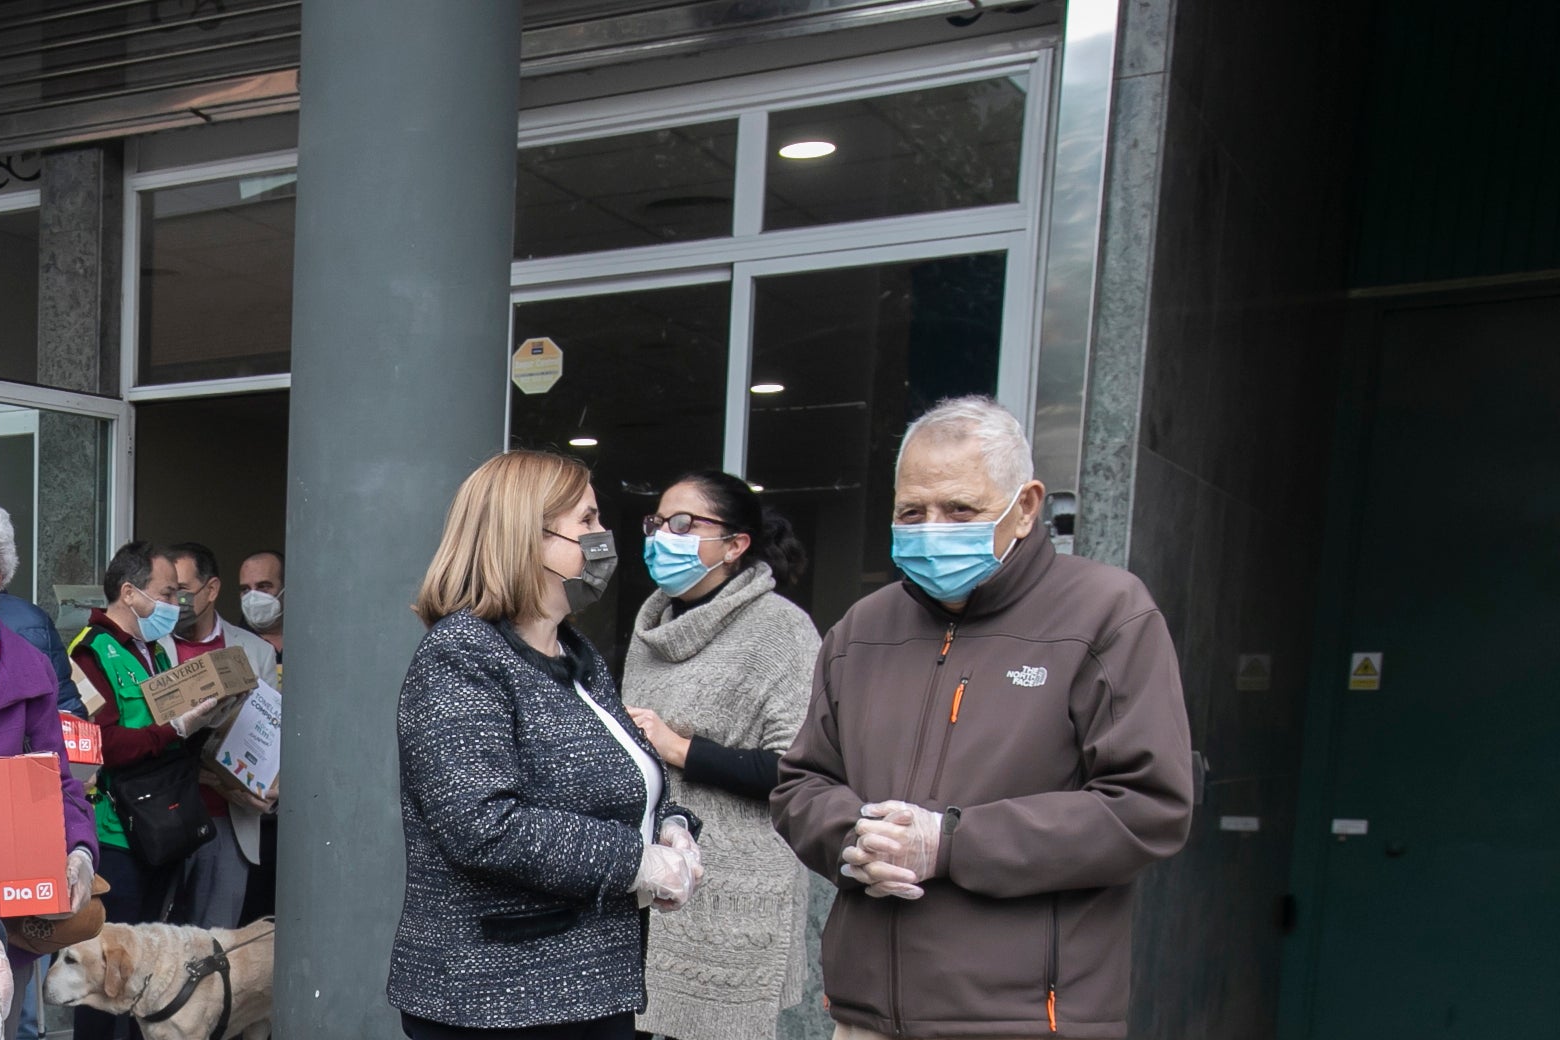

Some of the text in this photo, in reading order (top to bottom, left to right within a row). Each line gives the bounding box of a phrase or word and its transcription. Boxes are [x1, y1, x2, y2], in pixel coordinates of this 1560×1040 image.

[149, 674, 174, 691] CAJA
[172, 659, 206, 680] VERDE
[1006, 670, 1037, 680] NORTH
[1022, 665, 1039, 675] THE
[1012, 677, 1034, 687] FACE
